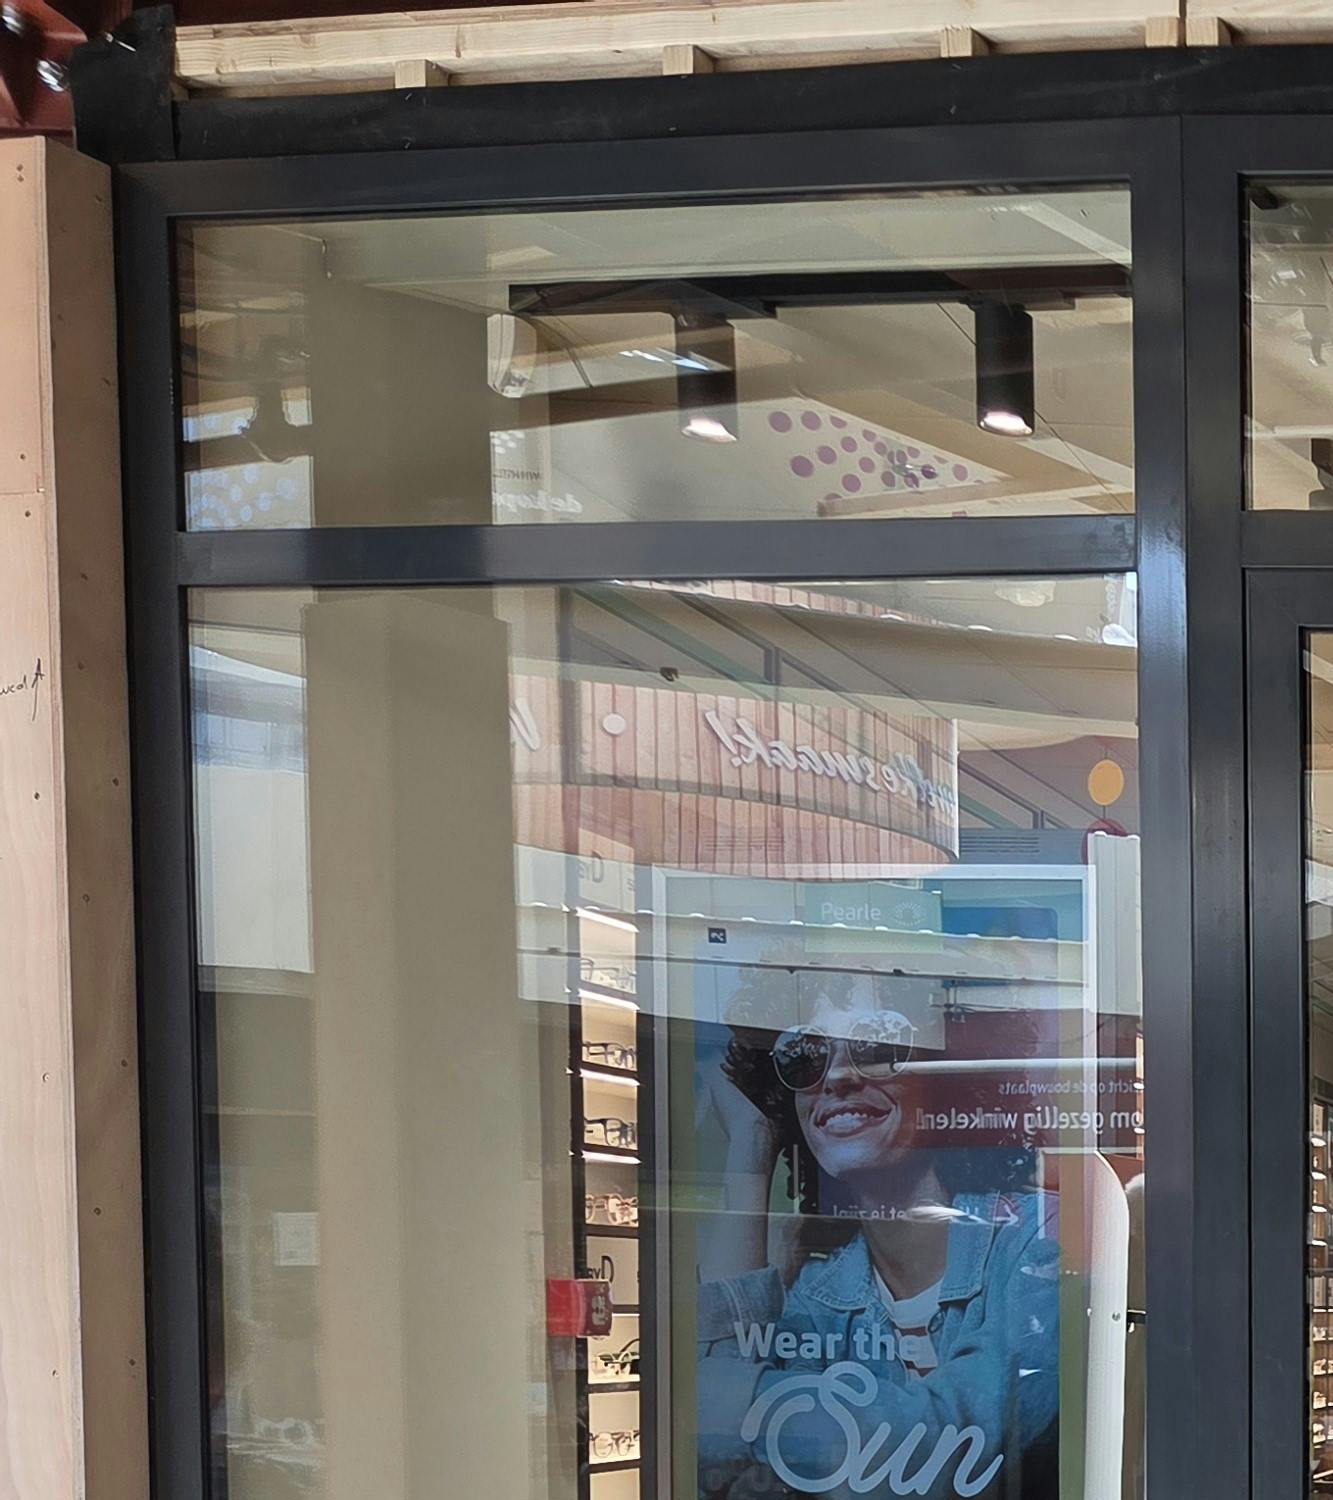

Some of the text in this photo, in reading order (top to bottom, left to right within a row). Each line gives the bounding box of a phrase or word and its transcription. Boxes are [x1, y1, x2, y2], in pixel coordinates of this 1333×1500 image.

[821, 901, 882, 921] Pearle
[733, 1321, 921, 1363] Wear the
[740, 1361, 1004, 1498] Sun
